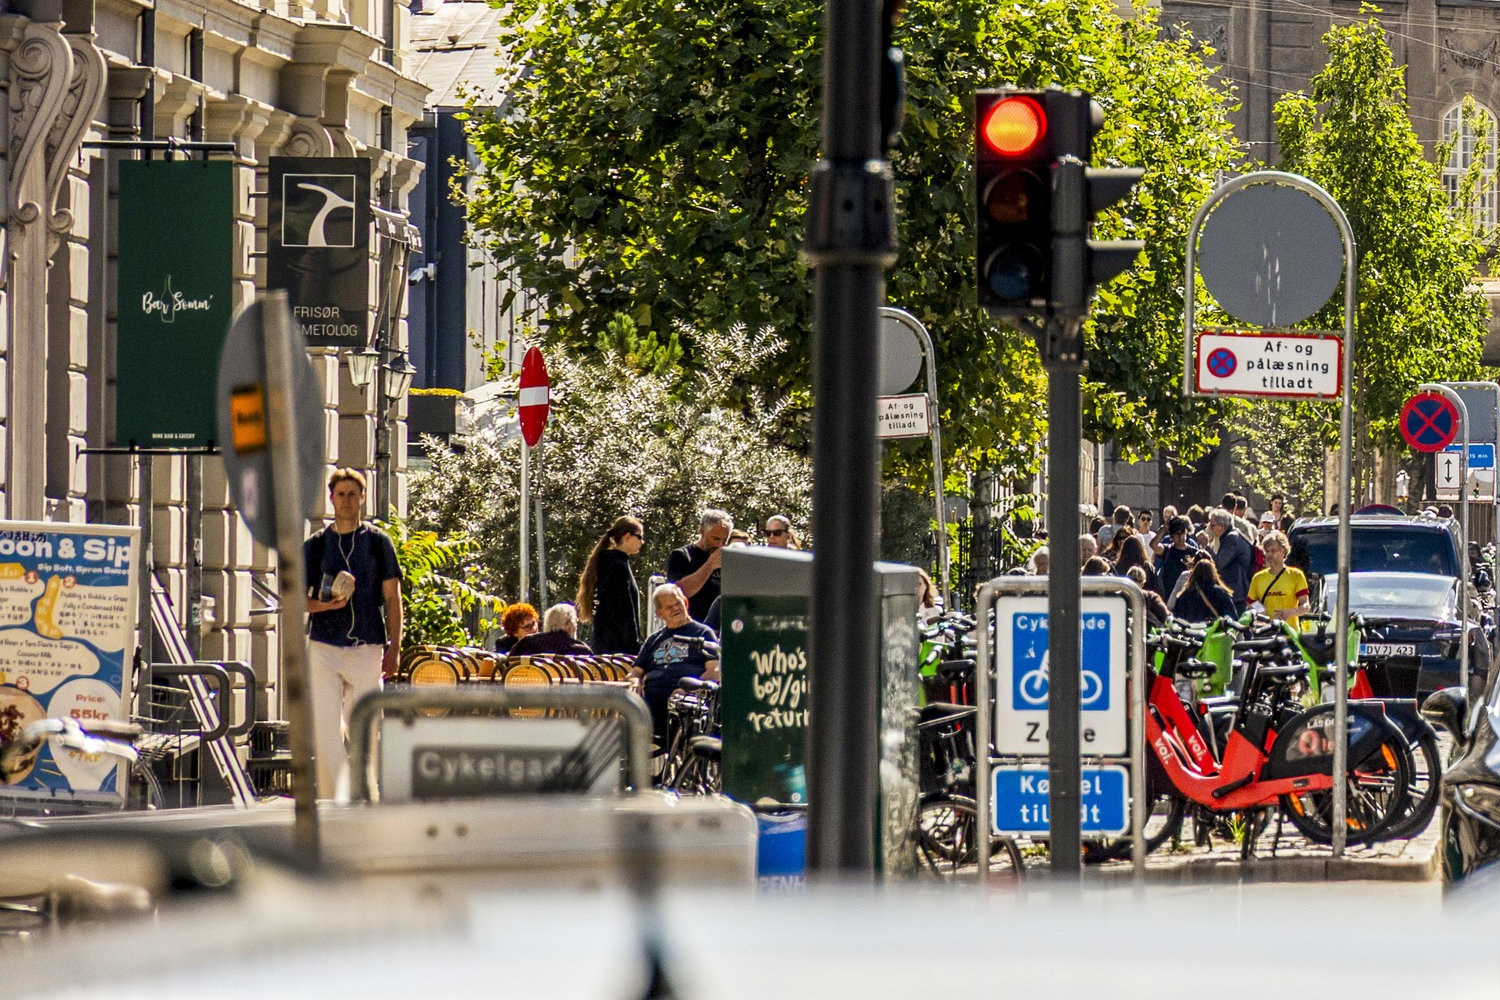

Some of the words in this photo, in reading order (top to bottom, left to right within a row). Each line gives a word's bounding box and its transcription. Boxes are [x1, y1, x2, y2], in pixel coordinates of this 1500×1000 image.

[142, 291, 169, 314] Bar
[293, 306, 340, 318] FRISØR
[301, 324, 358, 336] METOLOG
[1295, 344, 1313, 356] og
[1246, 357, 1330, 374] pålæsning
[1262, 376, 1313, 389] tilladt
[878, 412, 924, 422] pålæsning
[888, 421, 916, 430] tilladt
[58, 538, 77, 559] &
[83, 538, 130, 567] Sip
[1016, 616, 1106, 632] Cykde
[1366, 645, 1382, 655] DV
[753, 673, 811, 708] boy/gi
[70, 708, 109, 721] 55kr
[1026, 722, 1096, 742] Ze
[1020, 775, 1102, 795] Køel
[1020, 804, 1100, 823] tildt
